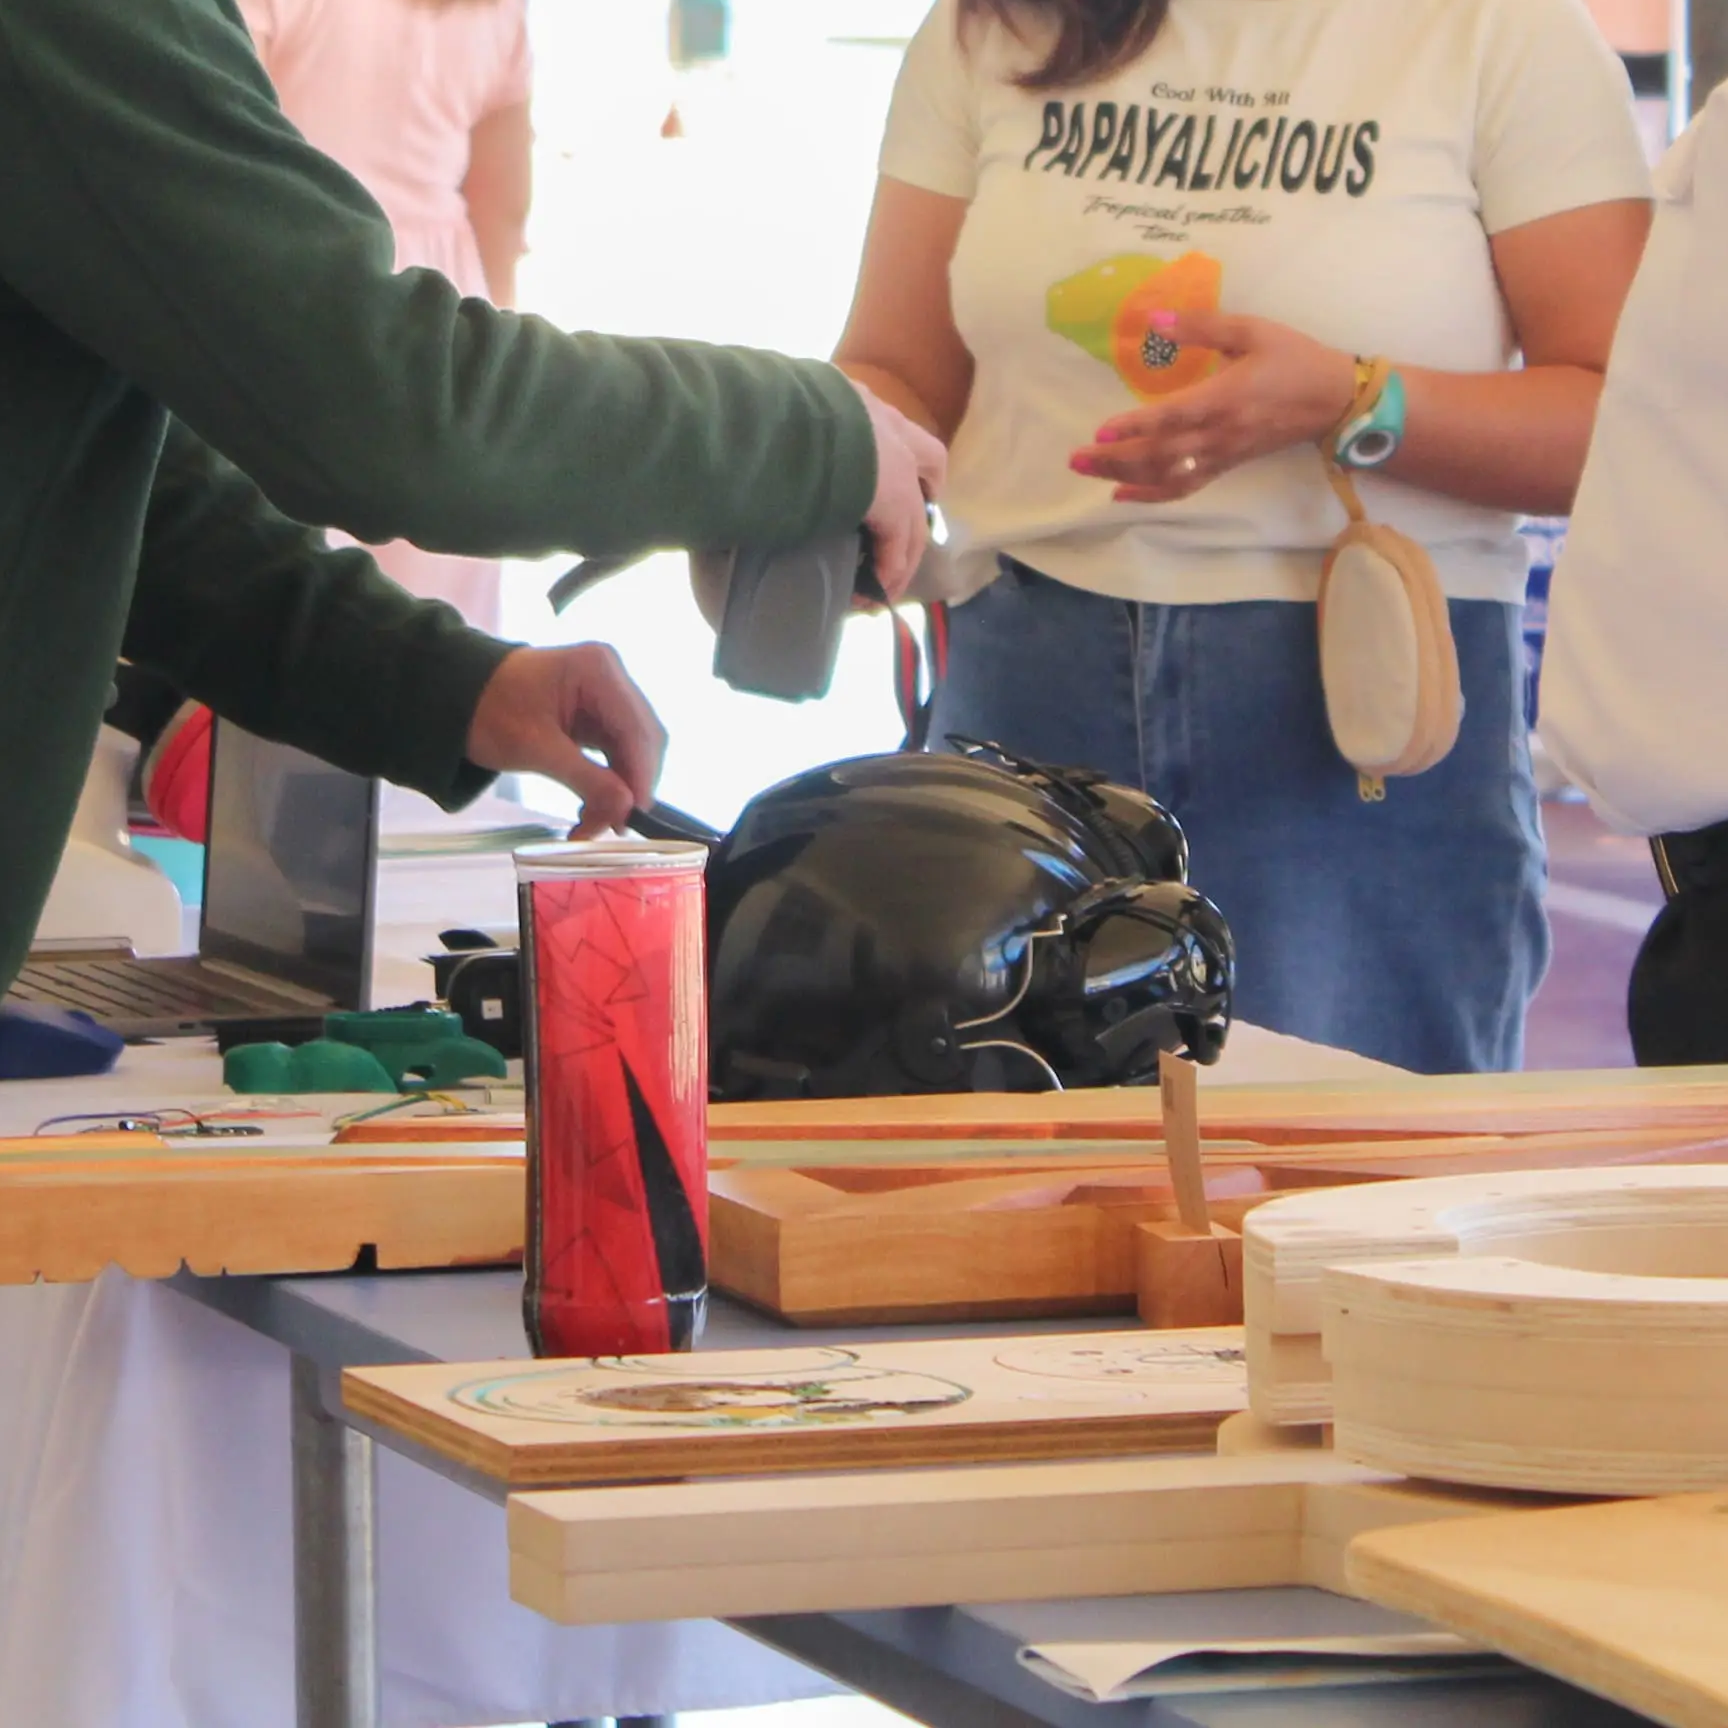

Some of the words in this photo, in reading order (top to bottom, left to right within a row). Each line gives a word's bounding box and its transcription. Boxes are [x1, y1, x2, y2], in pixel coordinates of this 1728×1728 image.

[1151, 82, 1196, 103] Cool
[1205, 87, 1255, 108] With
[1023, 101, 1379, 198] PAPAYALICIOUS
[1083, 195, 1186, 221] Tropical
